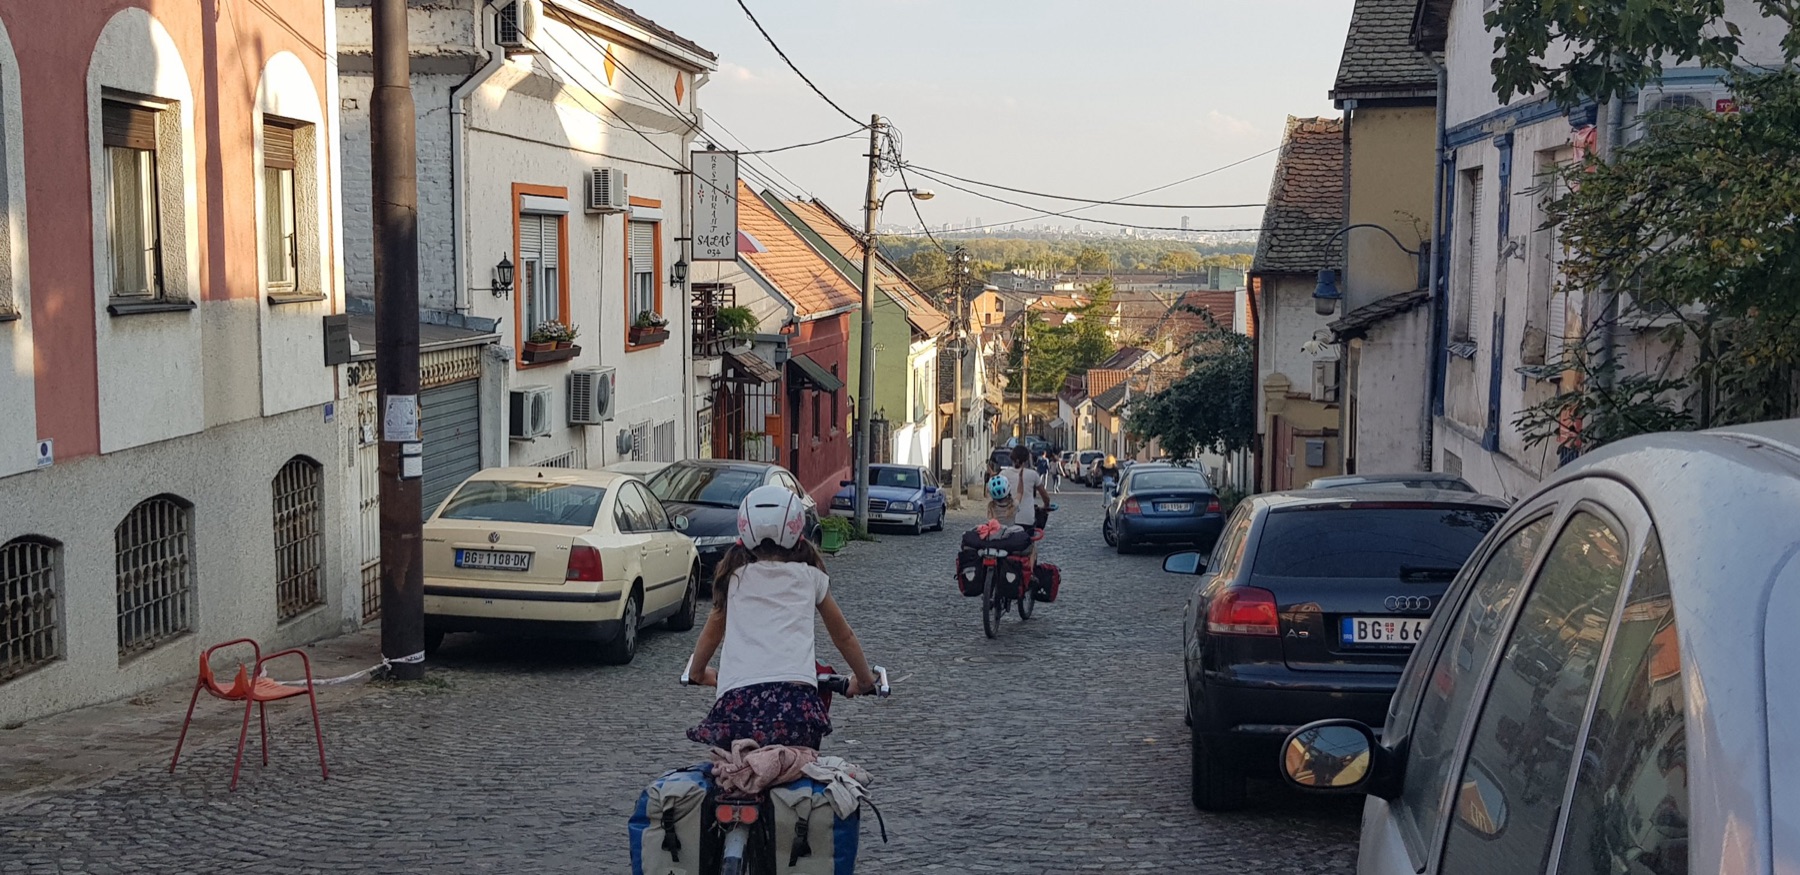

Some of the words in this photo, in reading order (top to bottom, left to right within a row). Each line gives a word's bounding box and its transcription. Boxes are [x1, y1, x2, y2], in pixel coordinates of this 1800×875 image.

[710, 155, 718, 233] RESTAURANT
[697, 232, 731, 247] SALAŠ
[347, 366, 360, 387] 36
[464, 551, 478, 564] BG
[1357, 620, 1382, 640] BG
